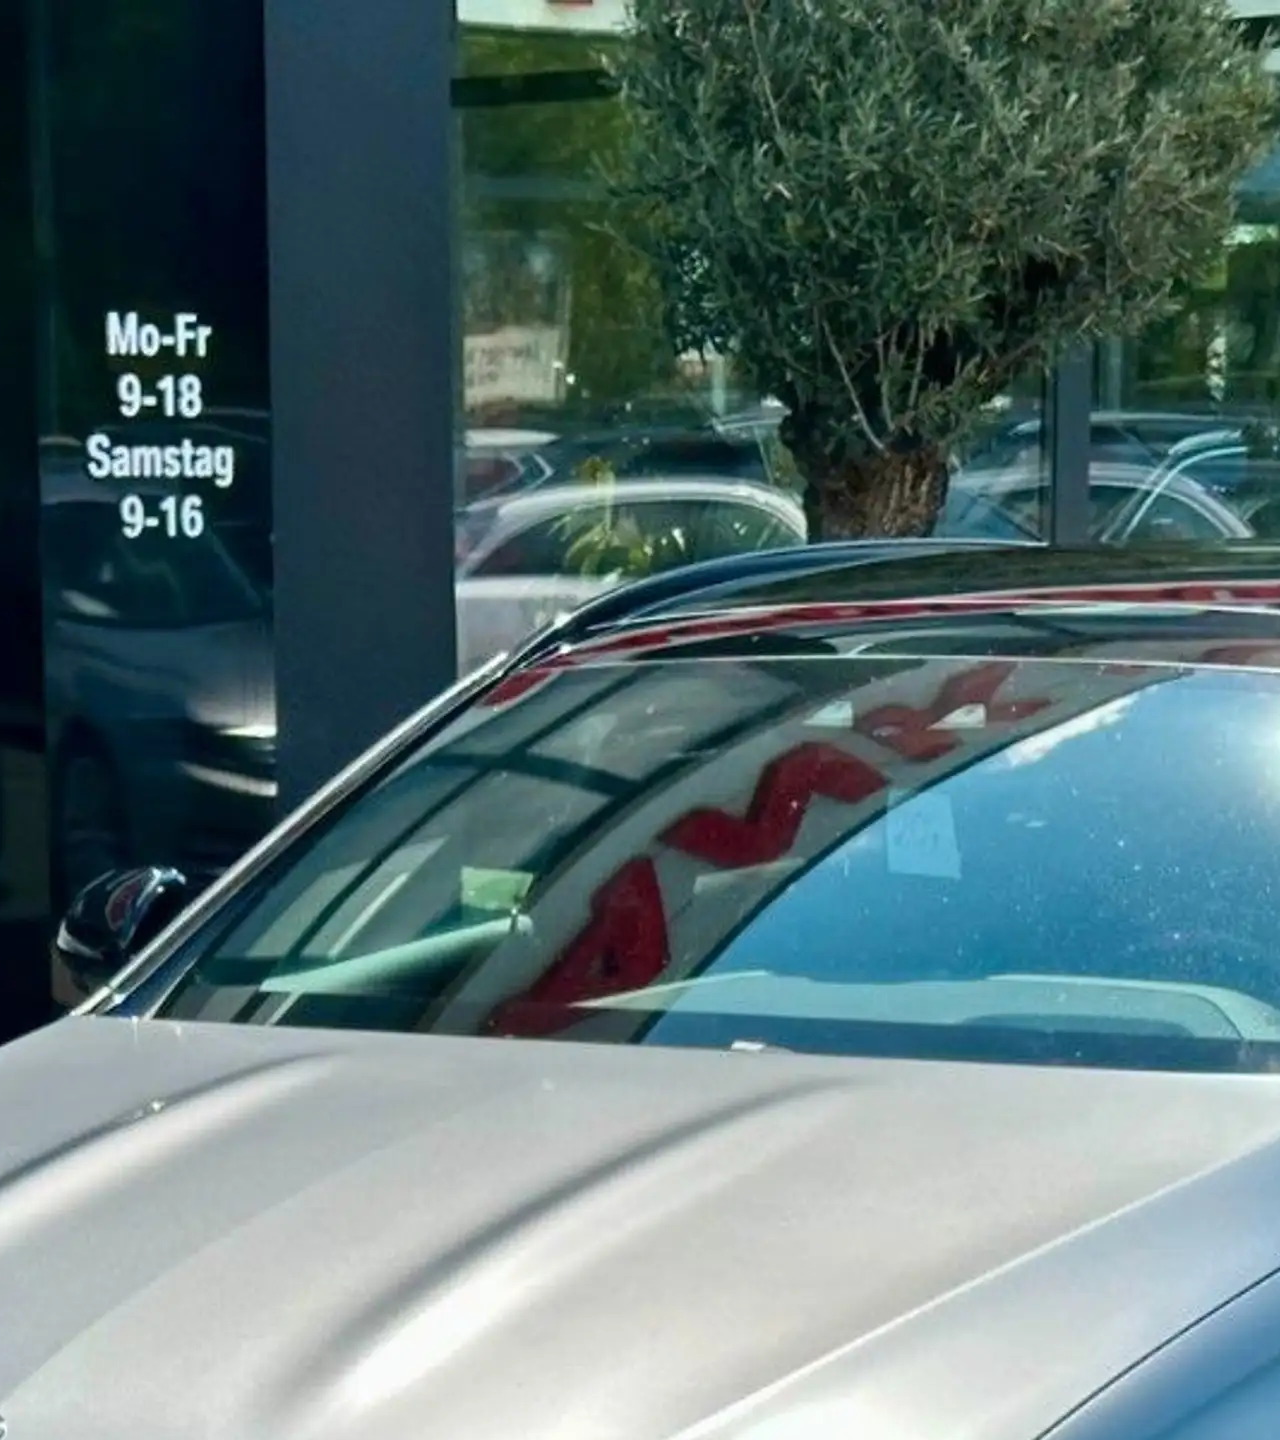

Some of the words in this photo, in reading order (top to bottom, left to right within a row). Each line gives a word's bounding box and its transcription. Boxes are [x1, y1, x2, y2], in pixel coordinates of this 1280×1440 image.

[106, 311, 212, 357] Mo-Fr
[117, 373, 202, 418] 9-18
[86, 433, 234, 488] Samstag
[120, 494, 204, 539] 9-16
